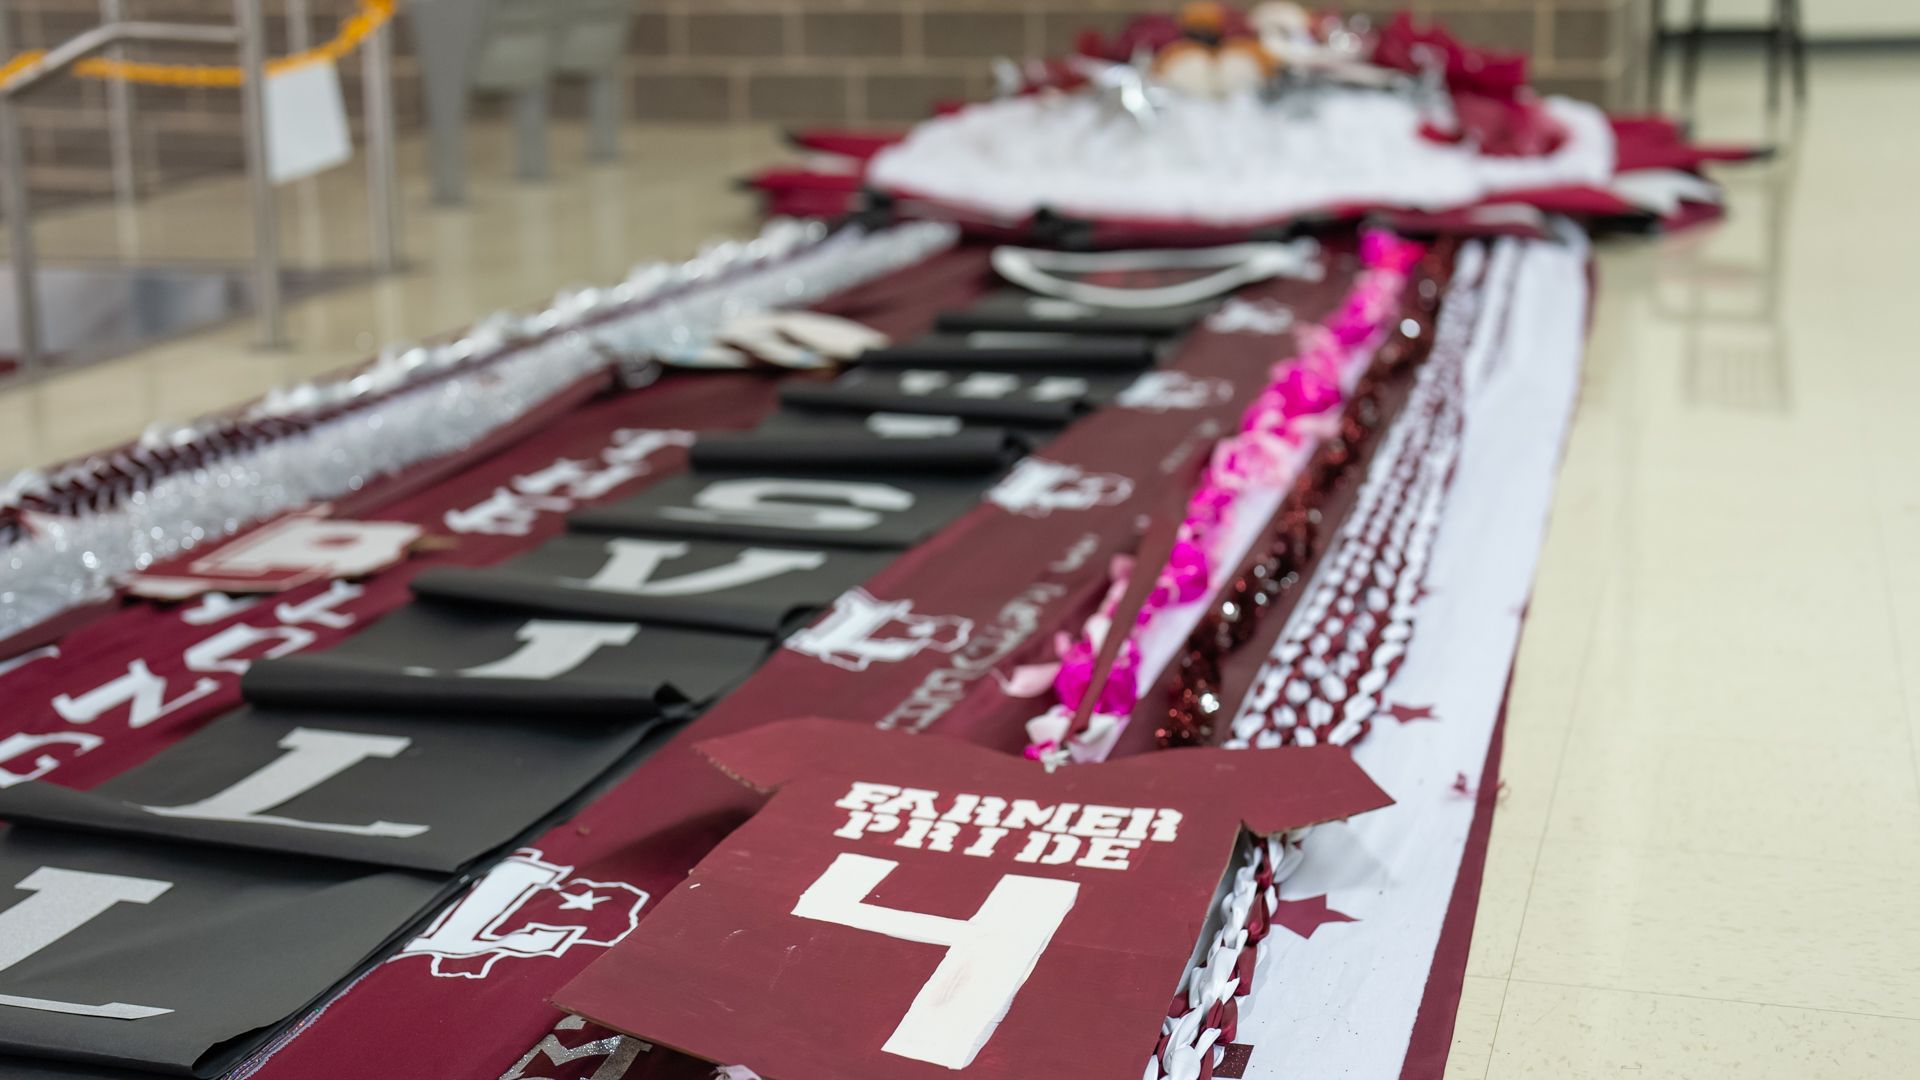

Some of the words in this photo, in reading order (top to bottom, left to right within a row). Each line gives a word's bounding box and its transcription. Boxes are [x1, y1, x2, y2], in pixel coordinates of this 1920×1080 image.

[833, 811, 1142, 870] PRIDE
[834, 781, 1184, 842] FARMER
[791, 852, 1082, 1070] 4
